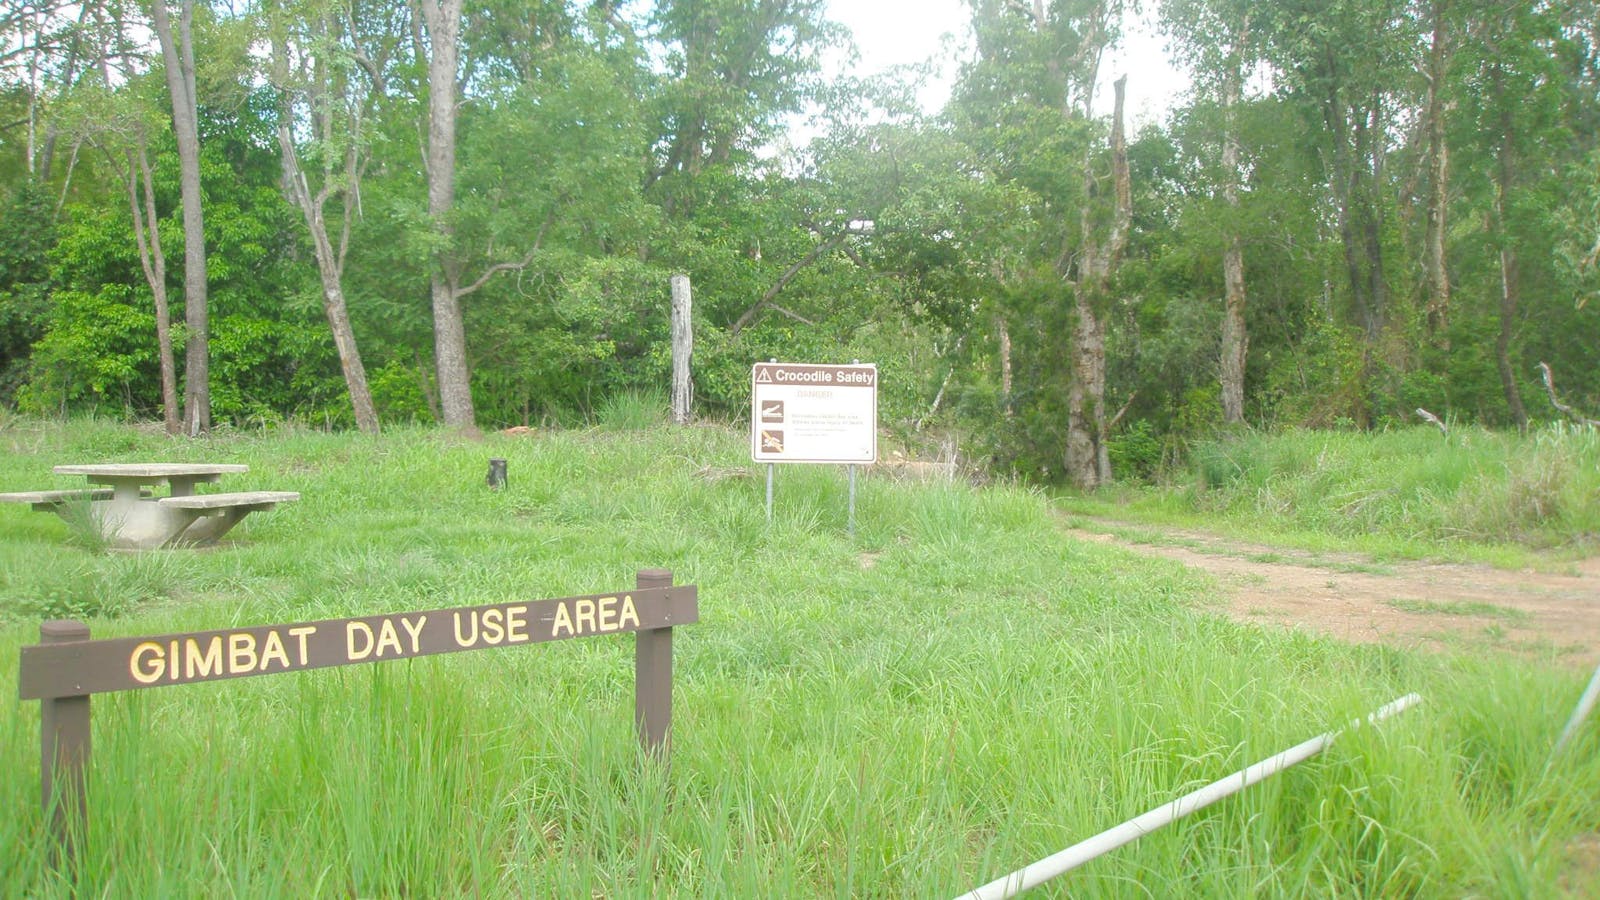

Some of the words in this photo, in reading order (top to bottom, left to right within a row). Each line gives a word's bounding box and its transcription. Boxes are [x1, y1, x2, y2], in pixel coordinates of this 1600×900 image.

[775, 369, 832, 382] Crocodile
[836, 371, 873, 385] Safety
[130, 627, 317, 684] GIMBAT
[346, 615, 427, 660] DAY
[453, 606, 529, 647] USE
[551, 595, 641, 637] AREA
